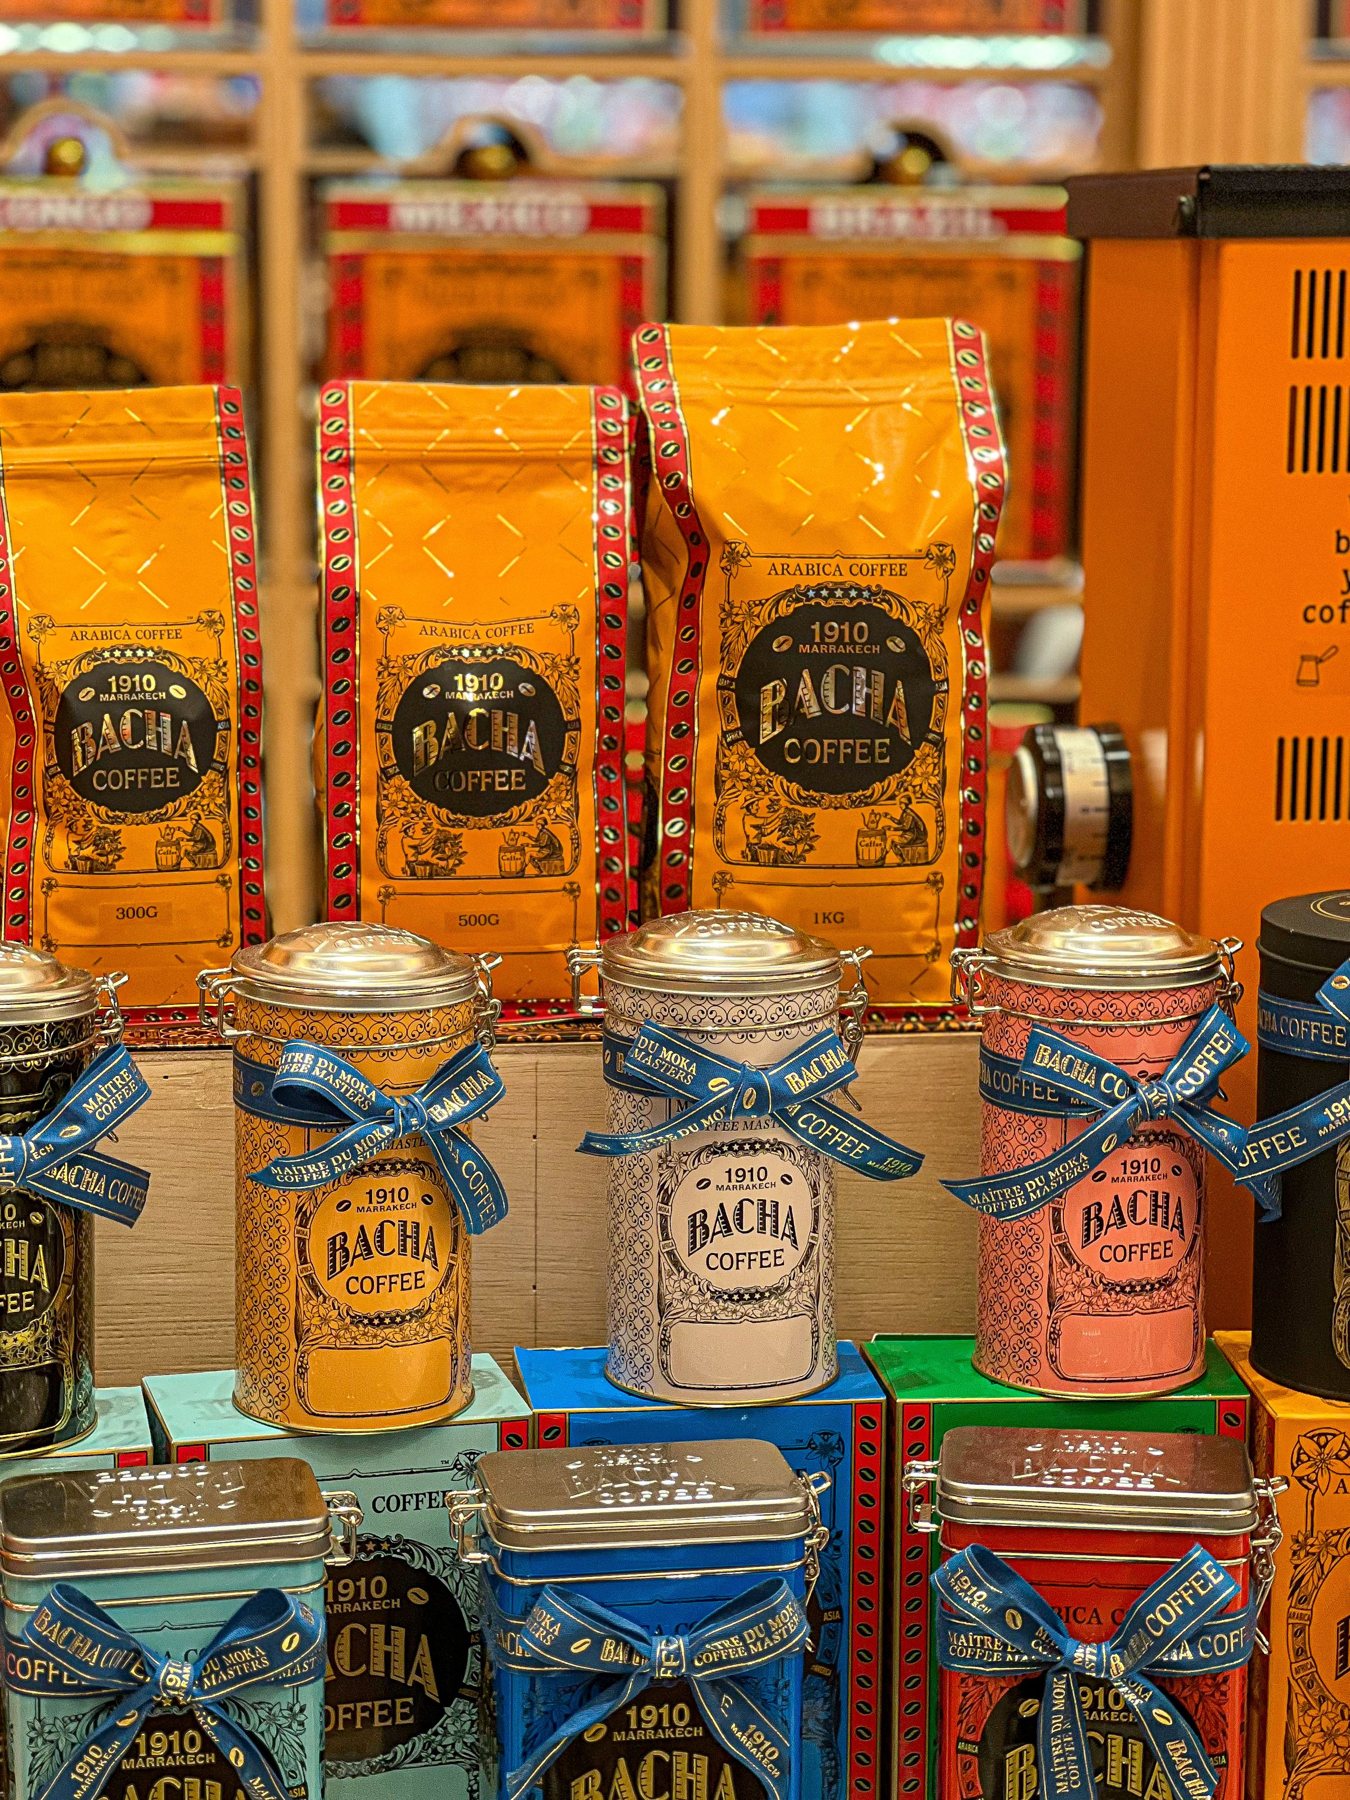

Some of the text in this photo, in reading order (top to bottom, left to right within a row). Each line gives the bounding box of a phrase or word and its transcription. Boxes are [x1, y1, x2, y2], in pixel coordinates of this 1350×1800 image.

[767, 563, 908, 577] ARABICA COFFEE
[70, 628, 183, 642] ARABICA COFFEE
[419, 623, 535, 640] ARABICA COFFEE
[810, 621, 868, 643] 1910
[799, 644, 881, 654] MARRAKECH
[108, 674, 156, 693] 1910
[454, 673, 503, 692] 1910
[100, 691, 166, 702] MARRAKECH
[445, 690, 514, 702] MARRAKECH
[760, 664, 912, 746] BACHA
[71, 709, 199, 777] BACHA
[412, 707, 546, 777] BACHA
[784, 738, 890, 764] COFFEE
[93, 768, 180, 791] COFFEE
[433, 769, 526, 792] COFFEE
[116, 906, 158, 920] 300G
[458, 914, 500, 927] 500G
[696, 920, 777, 938] COFFEE
[1279, 1015, 1347, 1047] COFFEE
[631, 1049, 693, 1085] MASTERS
[638, 1036, 697, 1075] DU MOKA
[1033, 1043, 1097, 1088] BACHA
[317, 1058, 338, 1074] DU
[340, 1069, 377, 1102] MOKA
[784, 1045, 848, 1094] BACHA
[95, 1079, 138, 1121] COFFEE
[276, 1064, 372, 1111] FFEE MASTERS
[427, 1069, 495, 1123] BACHA
[678, 1124, 699, 1137] DU
[701, 1105, 727, 1128] MO
[706, 1119, 777, 1132] FFEE MAST
[331, 1149, 352, 1165] DU
[353, 1124, 394, 1155] MOKA
[798, 1113, 913, 1172] COFFEE 1910
[1238, 1127, 1307, 1168] OFFEE
[276, 1170, 331, 1183] COFFEE
[725, 1166, 768, 1184] 1910
[1025, 1175, 1046, 1192] DU
[1048, 1152, 1088, 1180] MOKA
[1111, 1173, 1168, 1183] MARRAKECH
[1120, 1158, 1161, 1175] 1910
[716, 1181, 776, 1192] MARRAKECH
[1029, 1161, 1090, 1201] MASTERS
[356, 1202, 417, 1213] MARRAKECH
[366, 1186, 409, 1205] 1910
[462, 1160, 497, 1231] COFFEE
[688, 1198, 799, 1257] BACHA
[1082, 1190, 1185, 1249] BACHA
[327, 1219, 439, 1281] BACHA
[706, 1248, 784, 1271] COFFEE
[1100, 1240, 1173, 1263] COFFEE
[345, 1270, 426, 1296] COFFEE
[953, 1567, 988, 1602] 1910
[325, 1598, 401, 1614] ARRAKECH
[1145, 1560, 1224, 1637] COFFEE
[744, 1624, 765, 1643] DU
[768, 1602, 797, 1631] MOK
[823, 1611, 841, 1622] ASIA
[33, 1606, 101, 1666] BACHA
[1198, 1626, 1248, 1658] COFF
[6, 1653, 80, 1684] COFF
[222, 1646, 265, 1667] MOKA
[325, 1623, 440, 1704] CHA
[694, 1647, 747, 1667] COFFEE
[1294, 1663, 1314, 1675] AFRICA
[204, 1656, 270, 1689] MASTERS
[1053, 1674, 1067, 1713] MOK
[1080, 1686, 1126, 1711] 910
[325, 1697, 415, 1732] OFFEE
[626, 1703, 690, 1729] 1910
[1051, 1714, 1064, 1734] DU
[1083, 1710, 1137, 1722] RAKECH
[136, 1730, 201, 1757] 1910
[613, 1727, 703, 1742] MARRAKECH
[745, 1724, 780, 1761] 1910
[958, 1742, 978, 1752] ARABICA
[71, 1745, 103, 1782] 1910
[122, 1753, 216, 1770] MARRAKECH
[731, 1723, 780, 1779] MARRAKECH
[73, 1741, 121, 1800] MARRAKECH
[1005, 1731, 1172, 1800] BCHA
